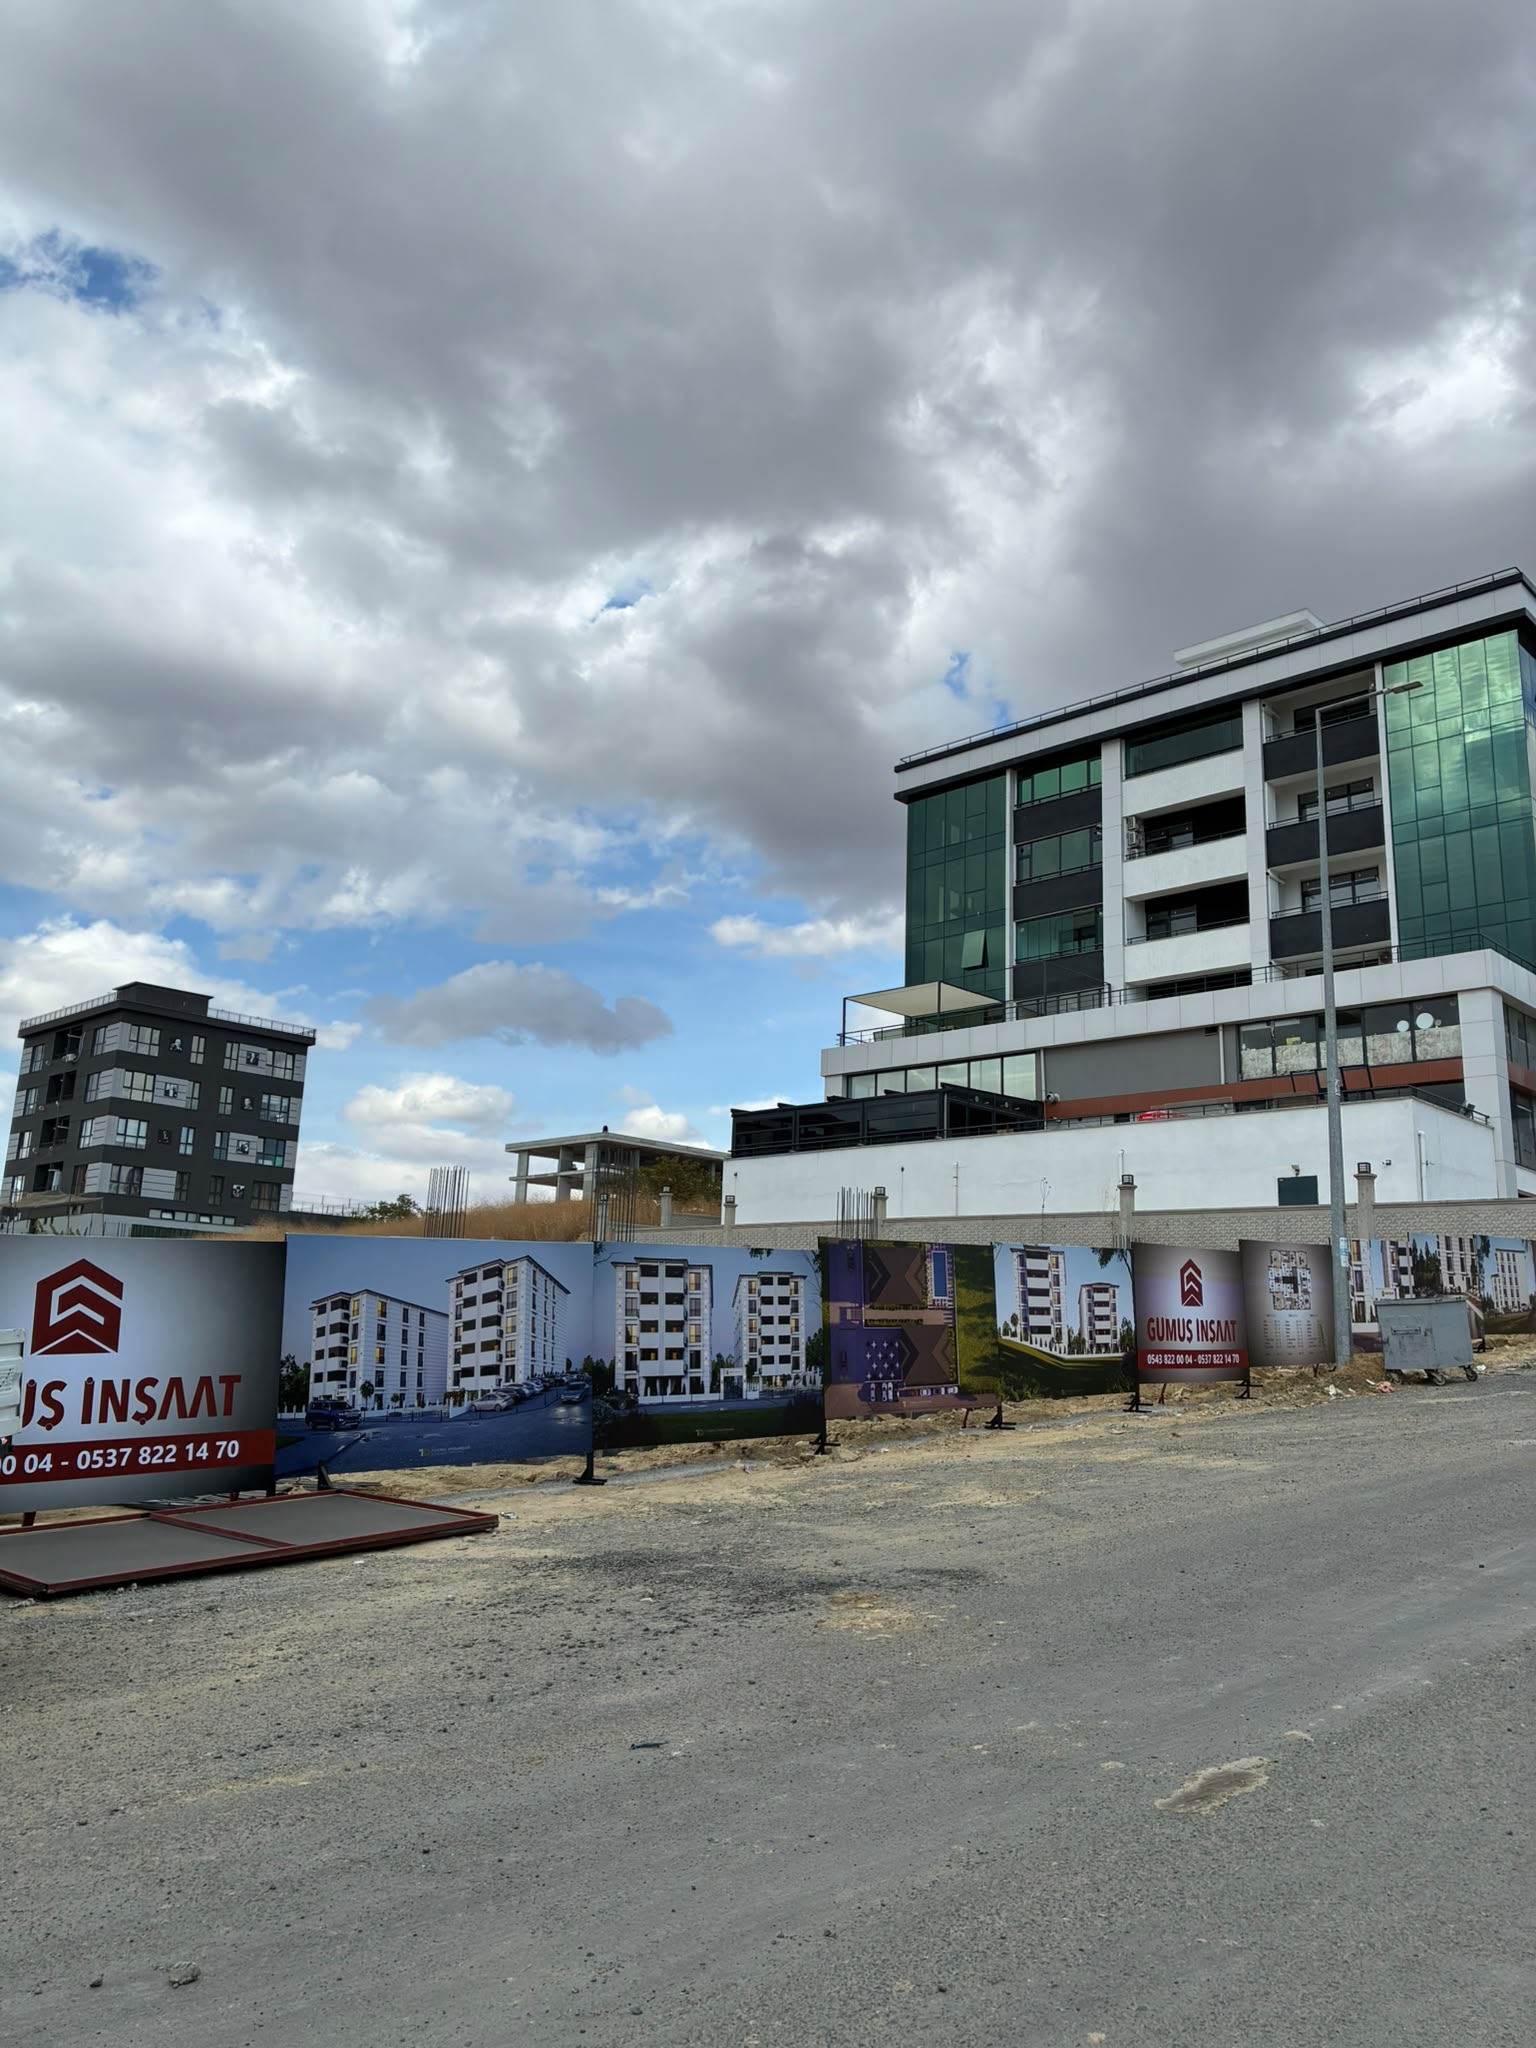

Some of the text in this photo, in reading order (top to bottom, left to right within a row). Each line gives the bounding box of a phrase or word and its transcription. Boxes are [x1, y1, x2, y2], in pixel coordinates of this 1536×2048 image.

[1147, 1354, 1163, 1365] 0543
[1163, 1354, 1176, 1365] 822
[1176, 1354, 1184, 1365] 00
[1184, 1354, 1193, 1365] 04
[1197, 1353, 1212, 1364] 0537
[1212, 1353, 1224, 1364] 822
[1224, 1353, 1232, 1364] 14
[1232, 1352, 1240, 1363] 70
[80, 1376, 242, 1426] İNŞAAT
[0, 1455, 17, 1476] 0
[23, 1453, 53, 1474] 04
[76, 1447, 133, 1470] 0537
[138, 1444, 178, 1465] 822
[185, 1441, 209, 1461] 14
[215, 1439, 240, 1459] 70
